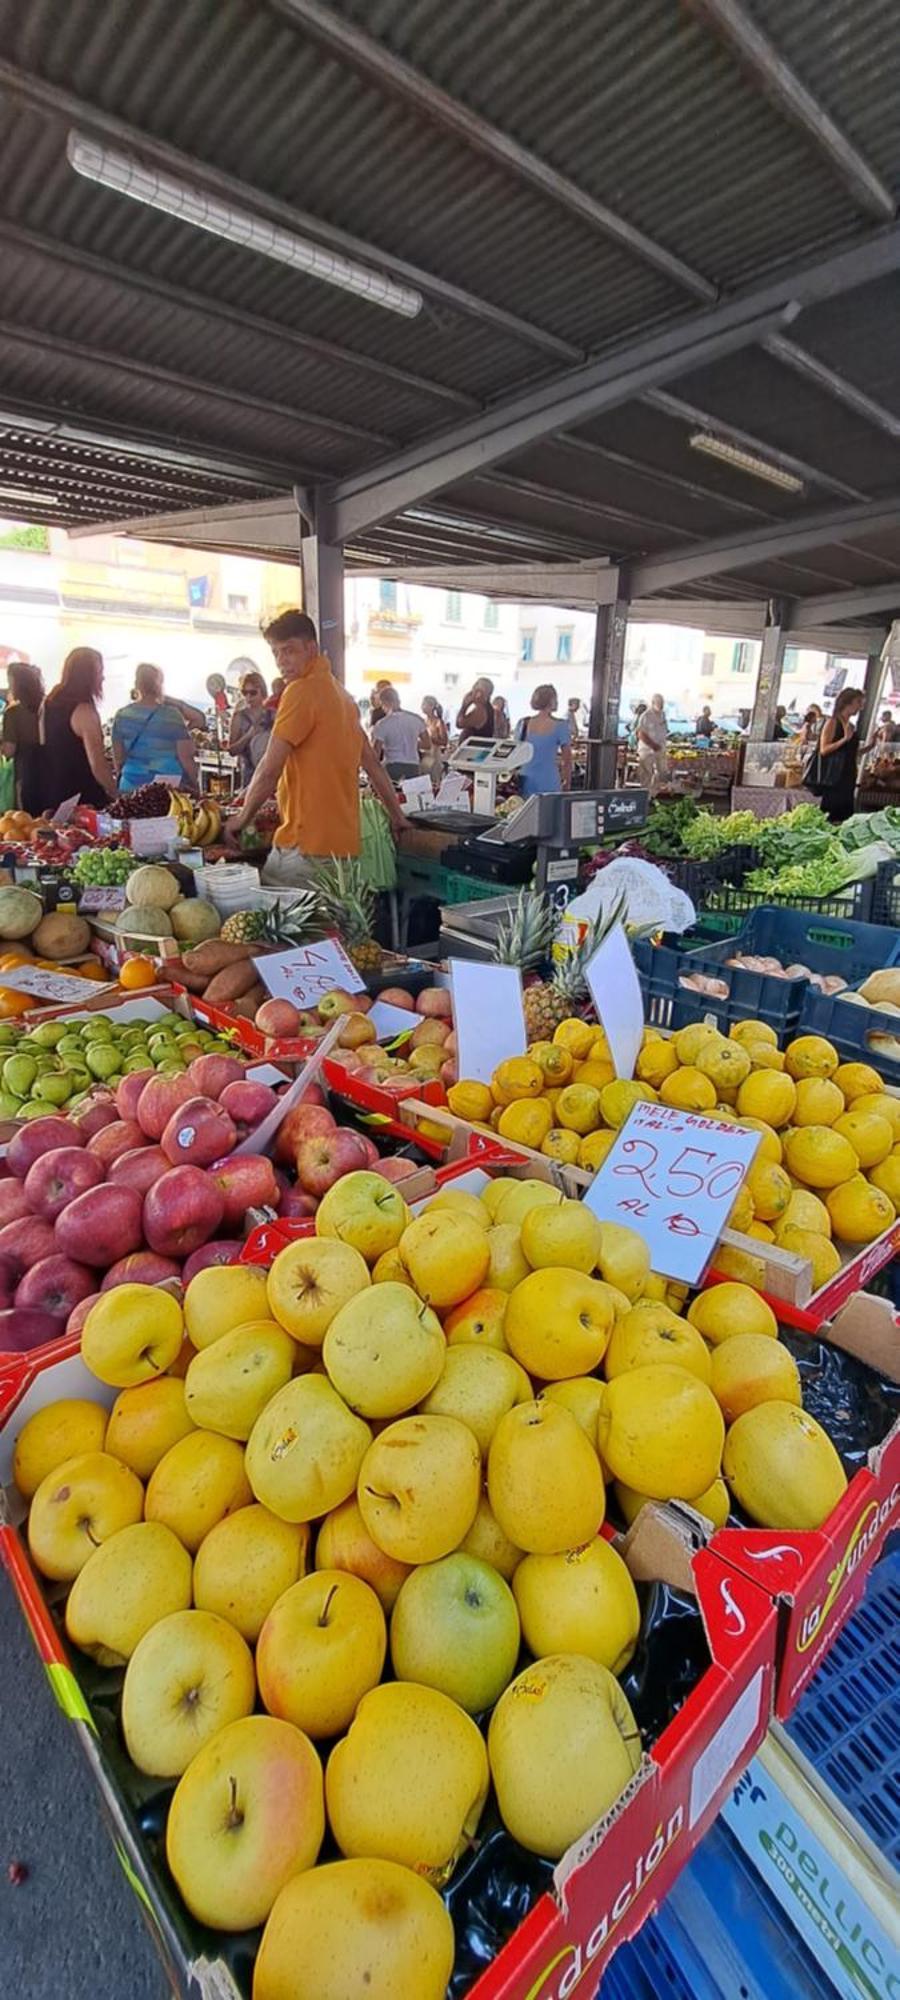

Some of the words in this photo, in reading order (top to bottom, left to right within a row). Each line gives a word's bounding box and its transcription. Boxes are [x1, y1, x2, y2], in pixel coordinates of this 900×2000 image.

[638, 1103, 680, 1121] MELE
[617, 1198, 649, 1217] AL
[548, 1805, 682, 2000] dación
